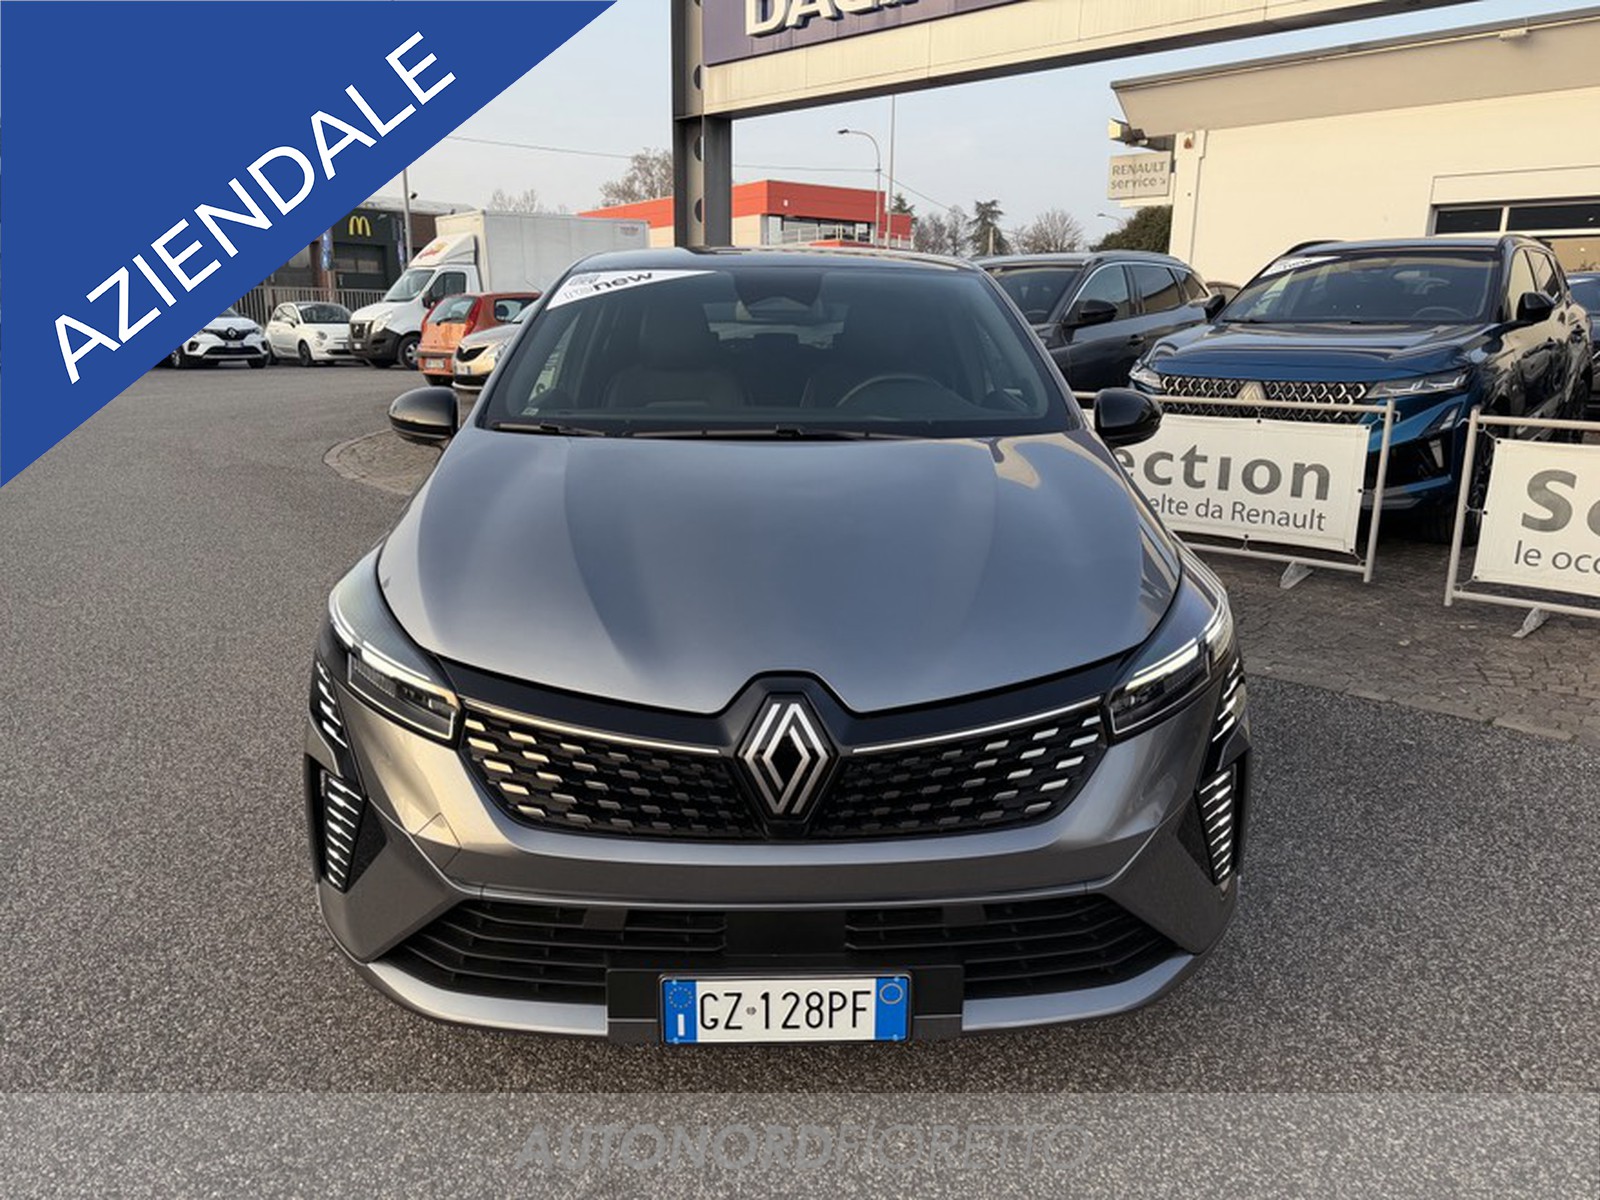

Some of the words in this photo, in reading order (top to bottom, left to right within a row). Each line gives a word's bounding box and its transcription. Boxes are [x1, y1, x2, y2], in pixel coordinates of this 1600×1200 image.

[1111, 161, 1166, 176] RENAULT
[1195, 497, 1224, 520] da
[1231, 501, 1326, 532] Renault
[1521, 469, 1600, 537] S
[1514, 540, 1542, 567] le
[760, 990, 871, 1030] 128PF
